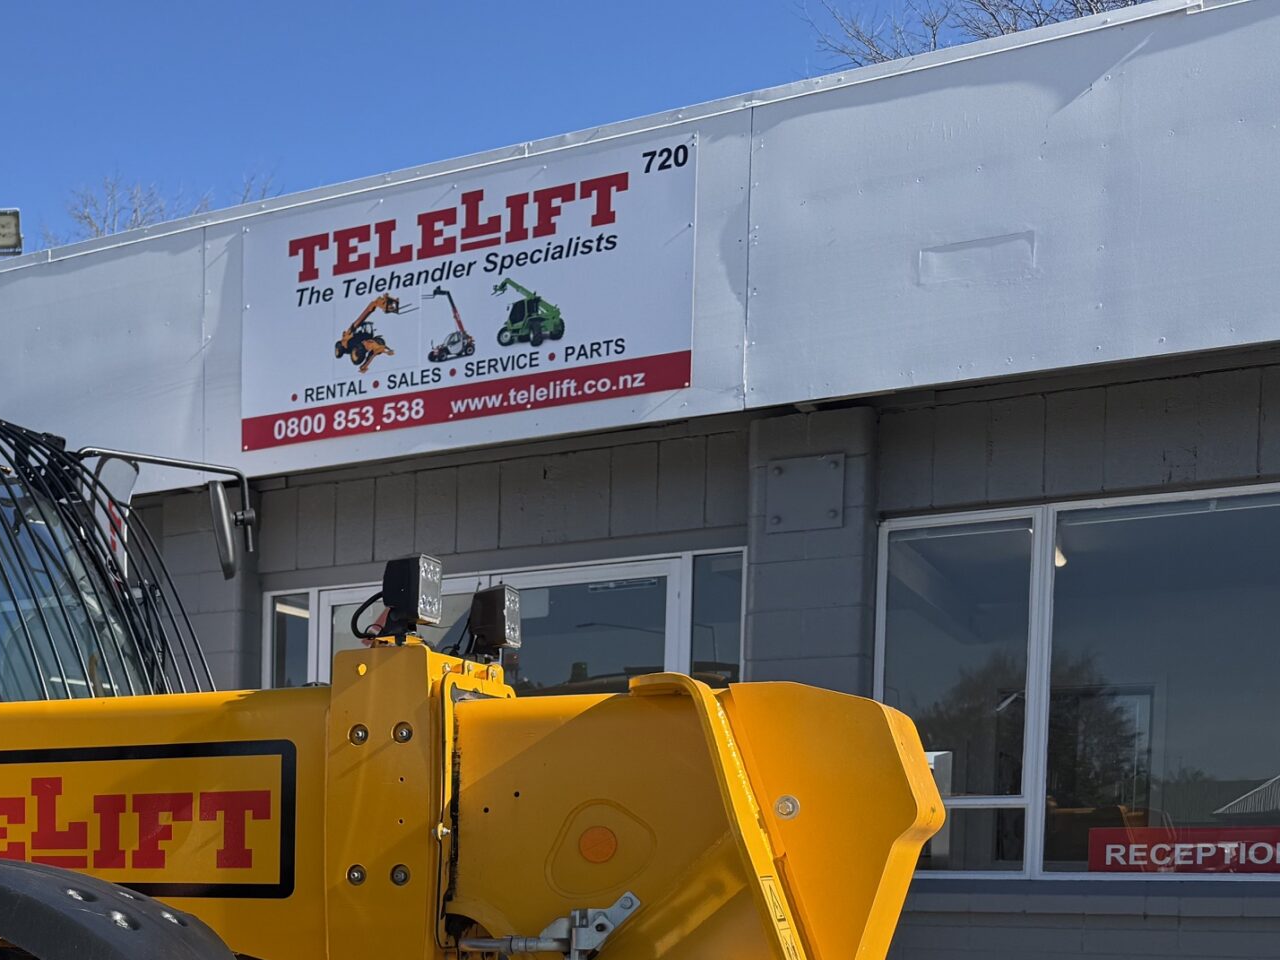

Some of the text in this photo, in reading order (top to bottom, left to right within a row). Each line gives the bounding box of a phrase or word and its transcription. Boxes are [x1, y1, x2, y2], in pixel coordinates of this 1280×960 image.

[642, 144, 689, 174] 720
[288, 171, 629, 283] TELELIFT
[296, 231, 619, 308] The Telehandler Specialists
[304, 338, 626, 403] RENTAL SALES SERVICE PARTS
[273, 372, 646, 441] 0800 853 538 www.telelift.co.nz
[1105, 842, 1280, 866] RECEPTIO
